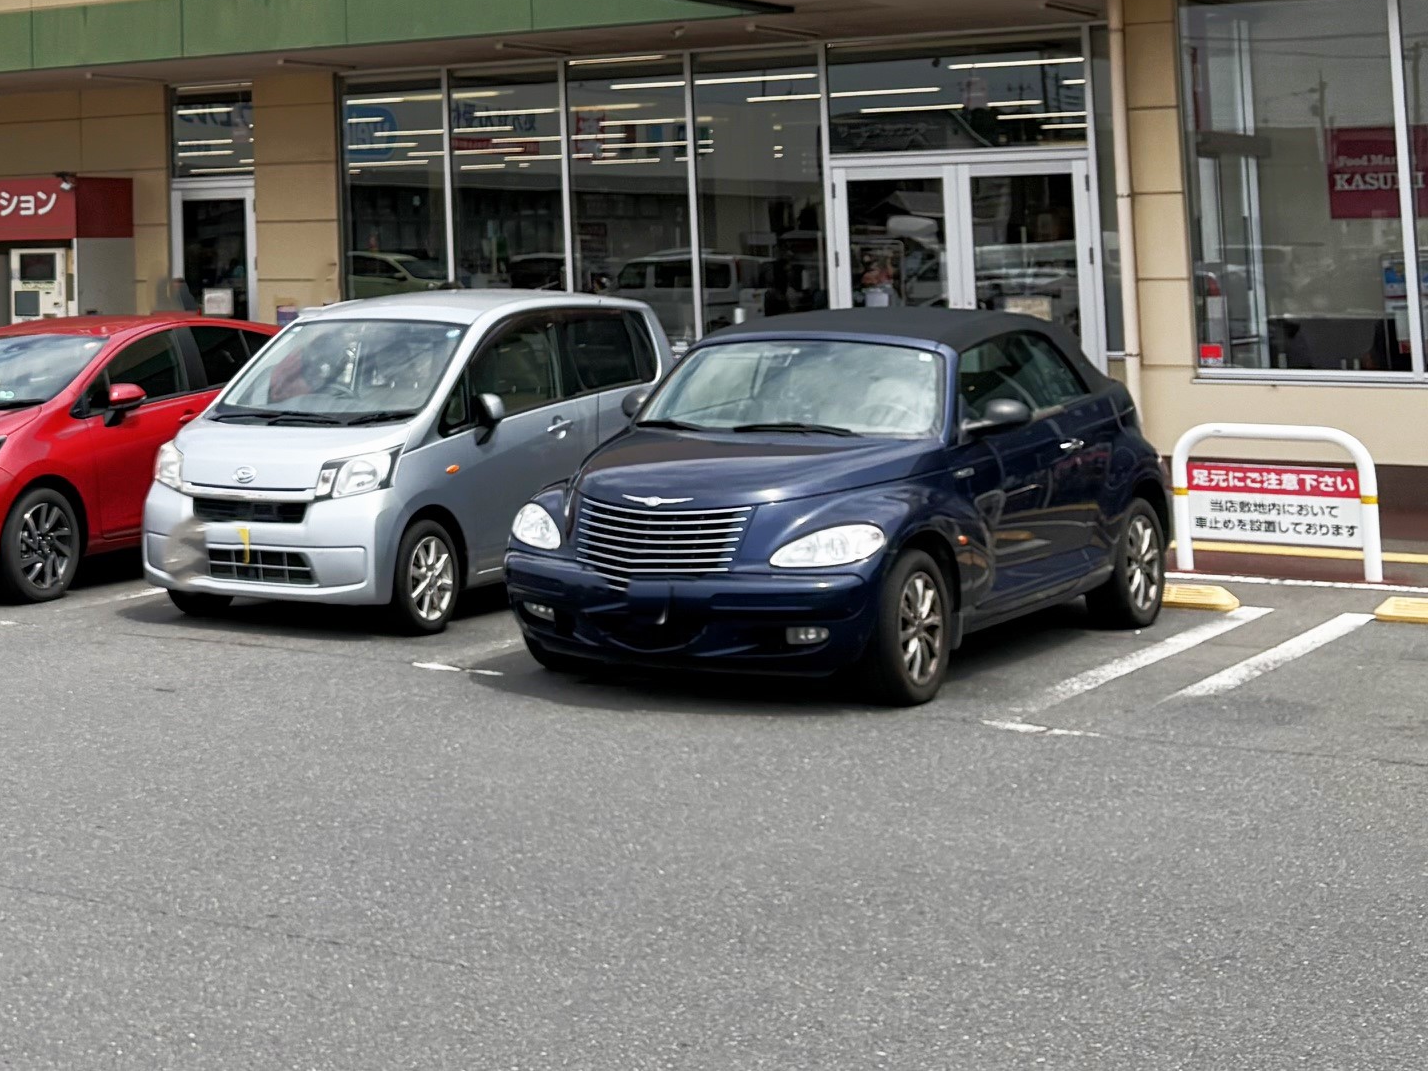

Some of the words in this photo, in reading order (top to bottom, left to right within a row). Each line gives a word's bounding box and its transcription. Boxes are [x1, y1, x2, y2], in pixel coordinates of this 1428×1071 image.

[1334, 172, 1425, 191] KASUI
[1191, 468, 1355, 493] 足元にご注意下さい
[1210, 498, 1341, 519] 当店敷地内において
[1195, 516, 1359, 538] 車止めを設置しております
